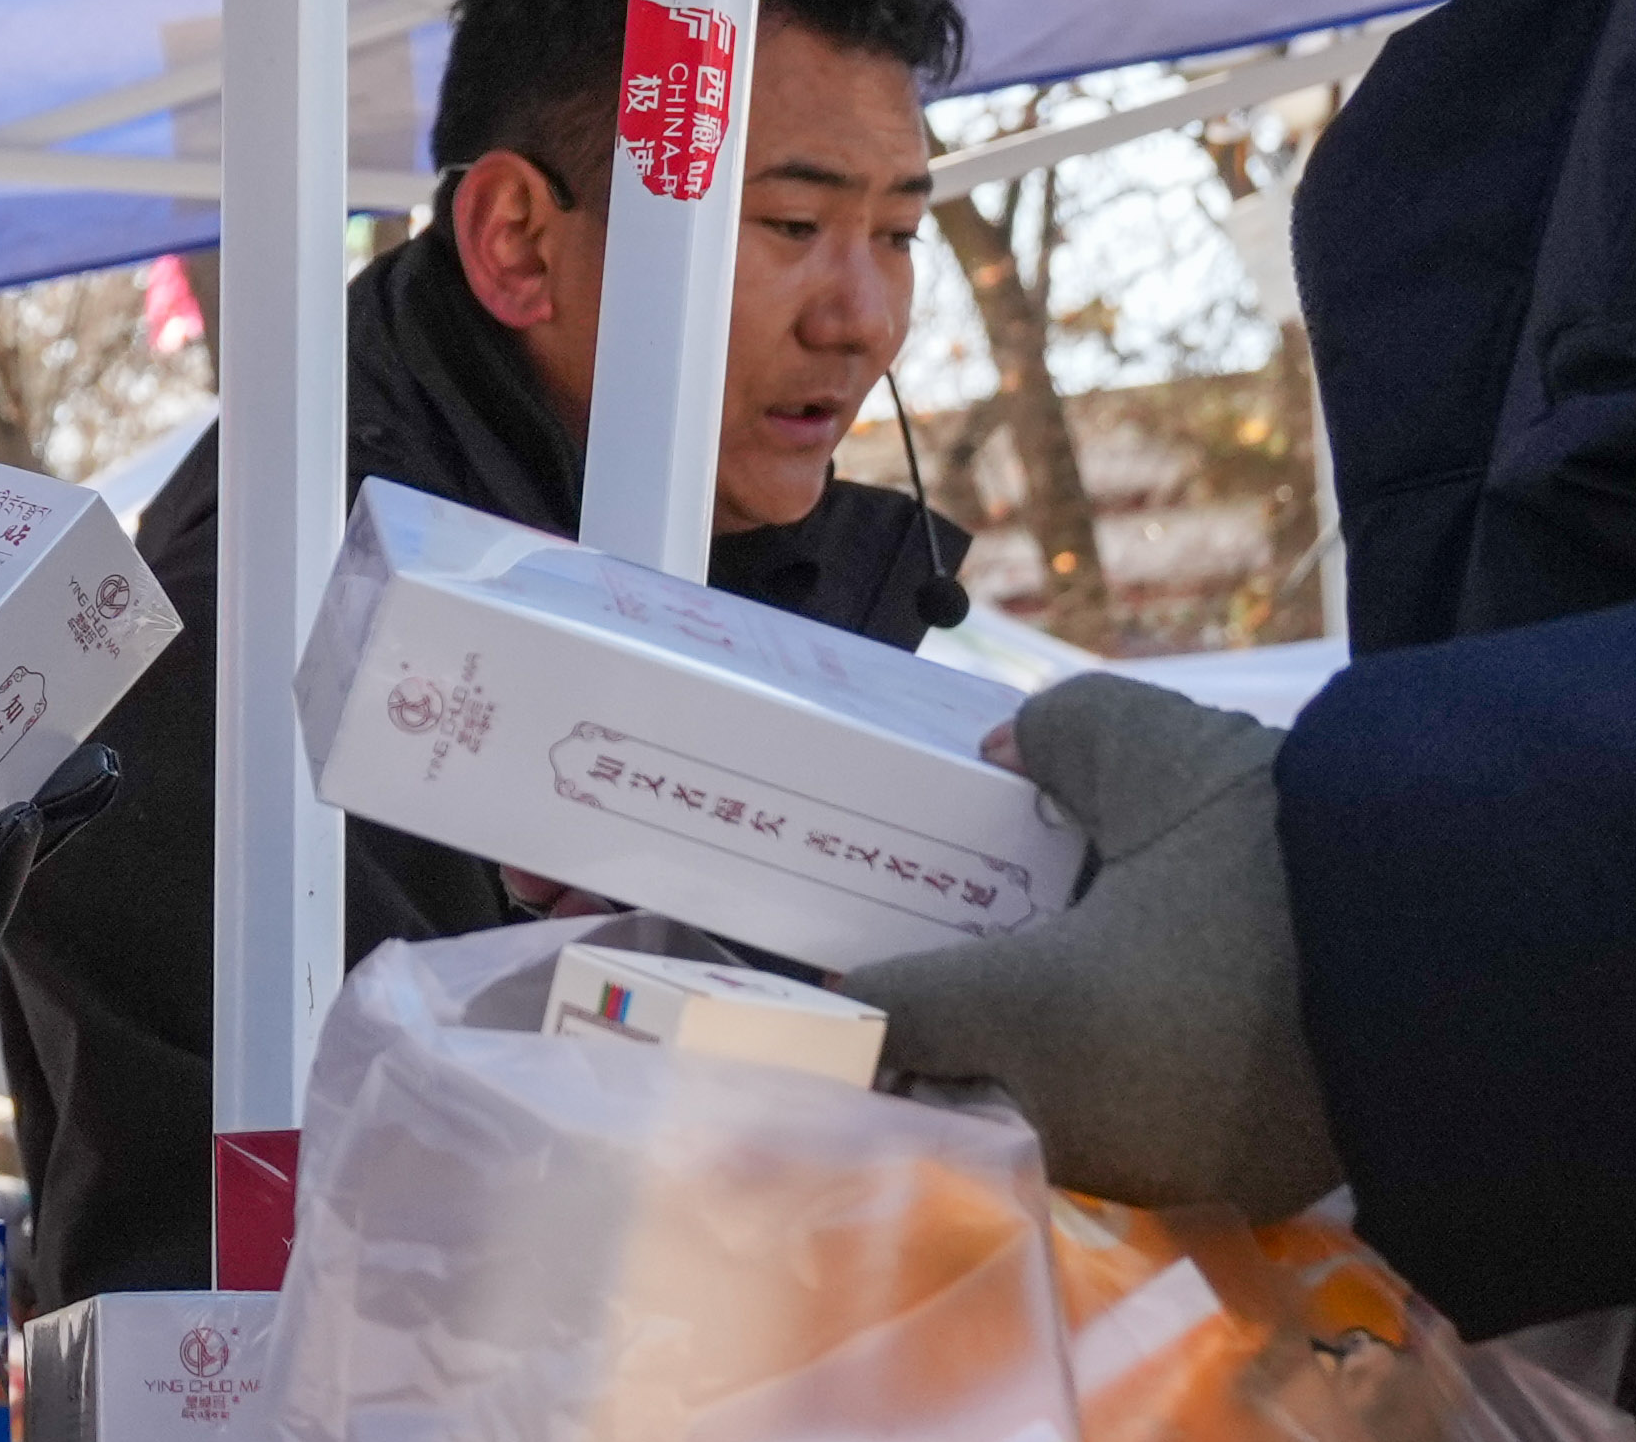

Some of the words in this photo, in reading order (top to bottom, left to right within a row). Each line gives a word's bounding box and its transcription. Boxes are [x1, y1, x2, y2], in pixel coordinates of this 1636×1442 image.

[661, 62, 689, 161] CHINA
[68, 575, 90, 607] YING
[144, 1378, 184, 1394] YING
[188, 1378, 233, 1394] CHUO
